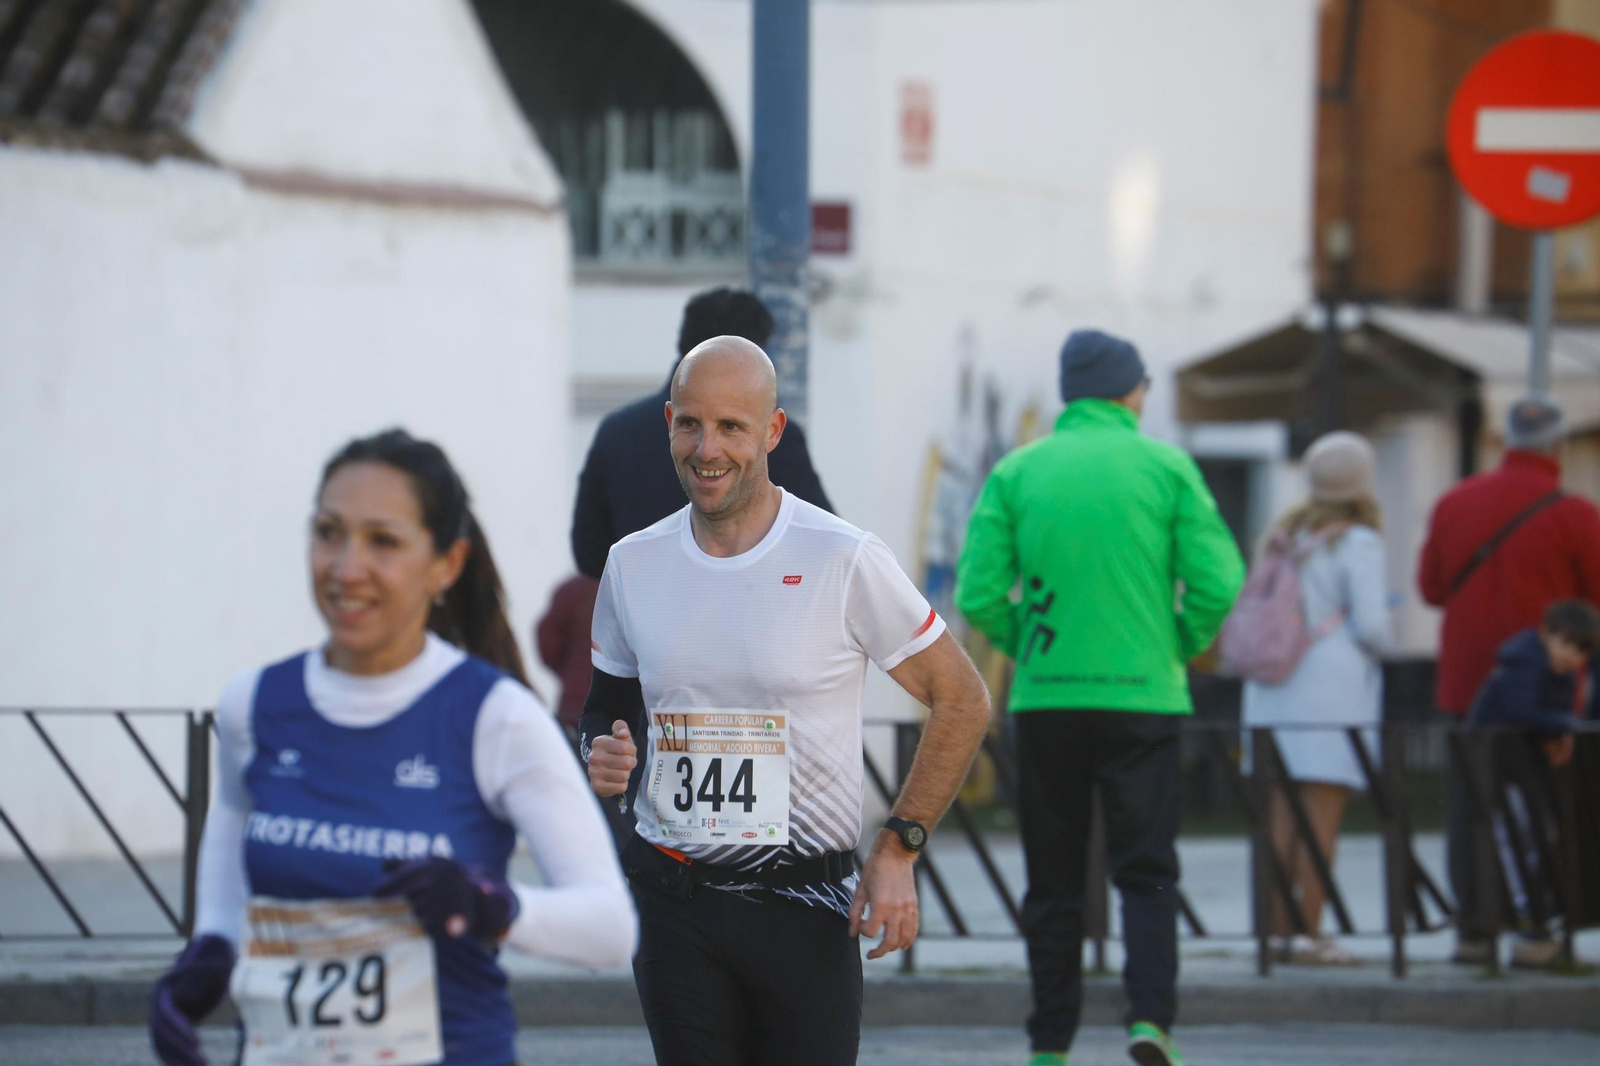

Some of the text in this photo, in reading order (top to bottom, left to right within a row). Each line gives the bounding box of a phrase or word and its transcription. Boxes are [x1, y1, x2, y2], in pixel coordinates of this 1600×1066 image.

[656, 714, 688, 752] XLI
[704, 715, 764, 726] CARRERA POPULAR
[689, 742, 780, 754] MEMORIAL "ADOLFO RIVERA"
[674, 756, 757, 813] 344
[282, 954, 386, 1028] 129
